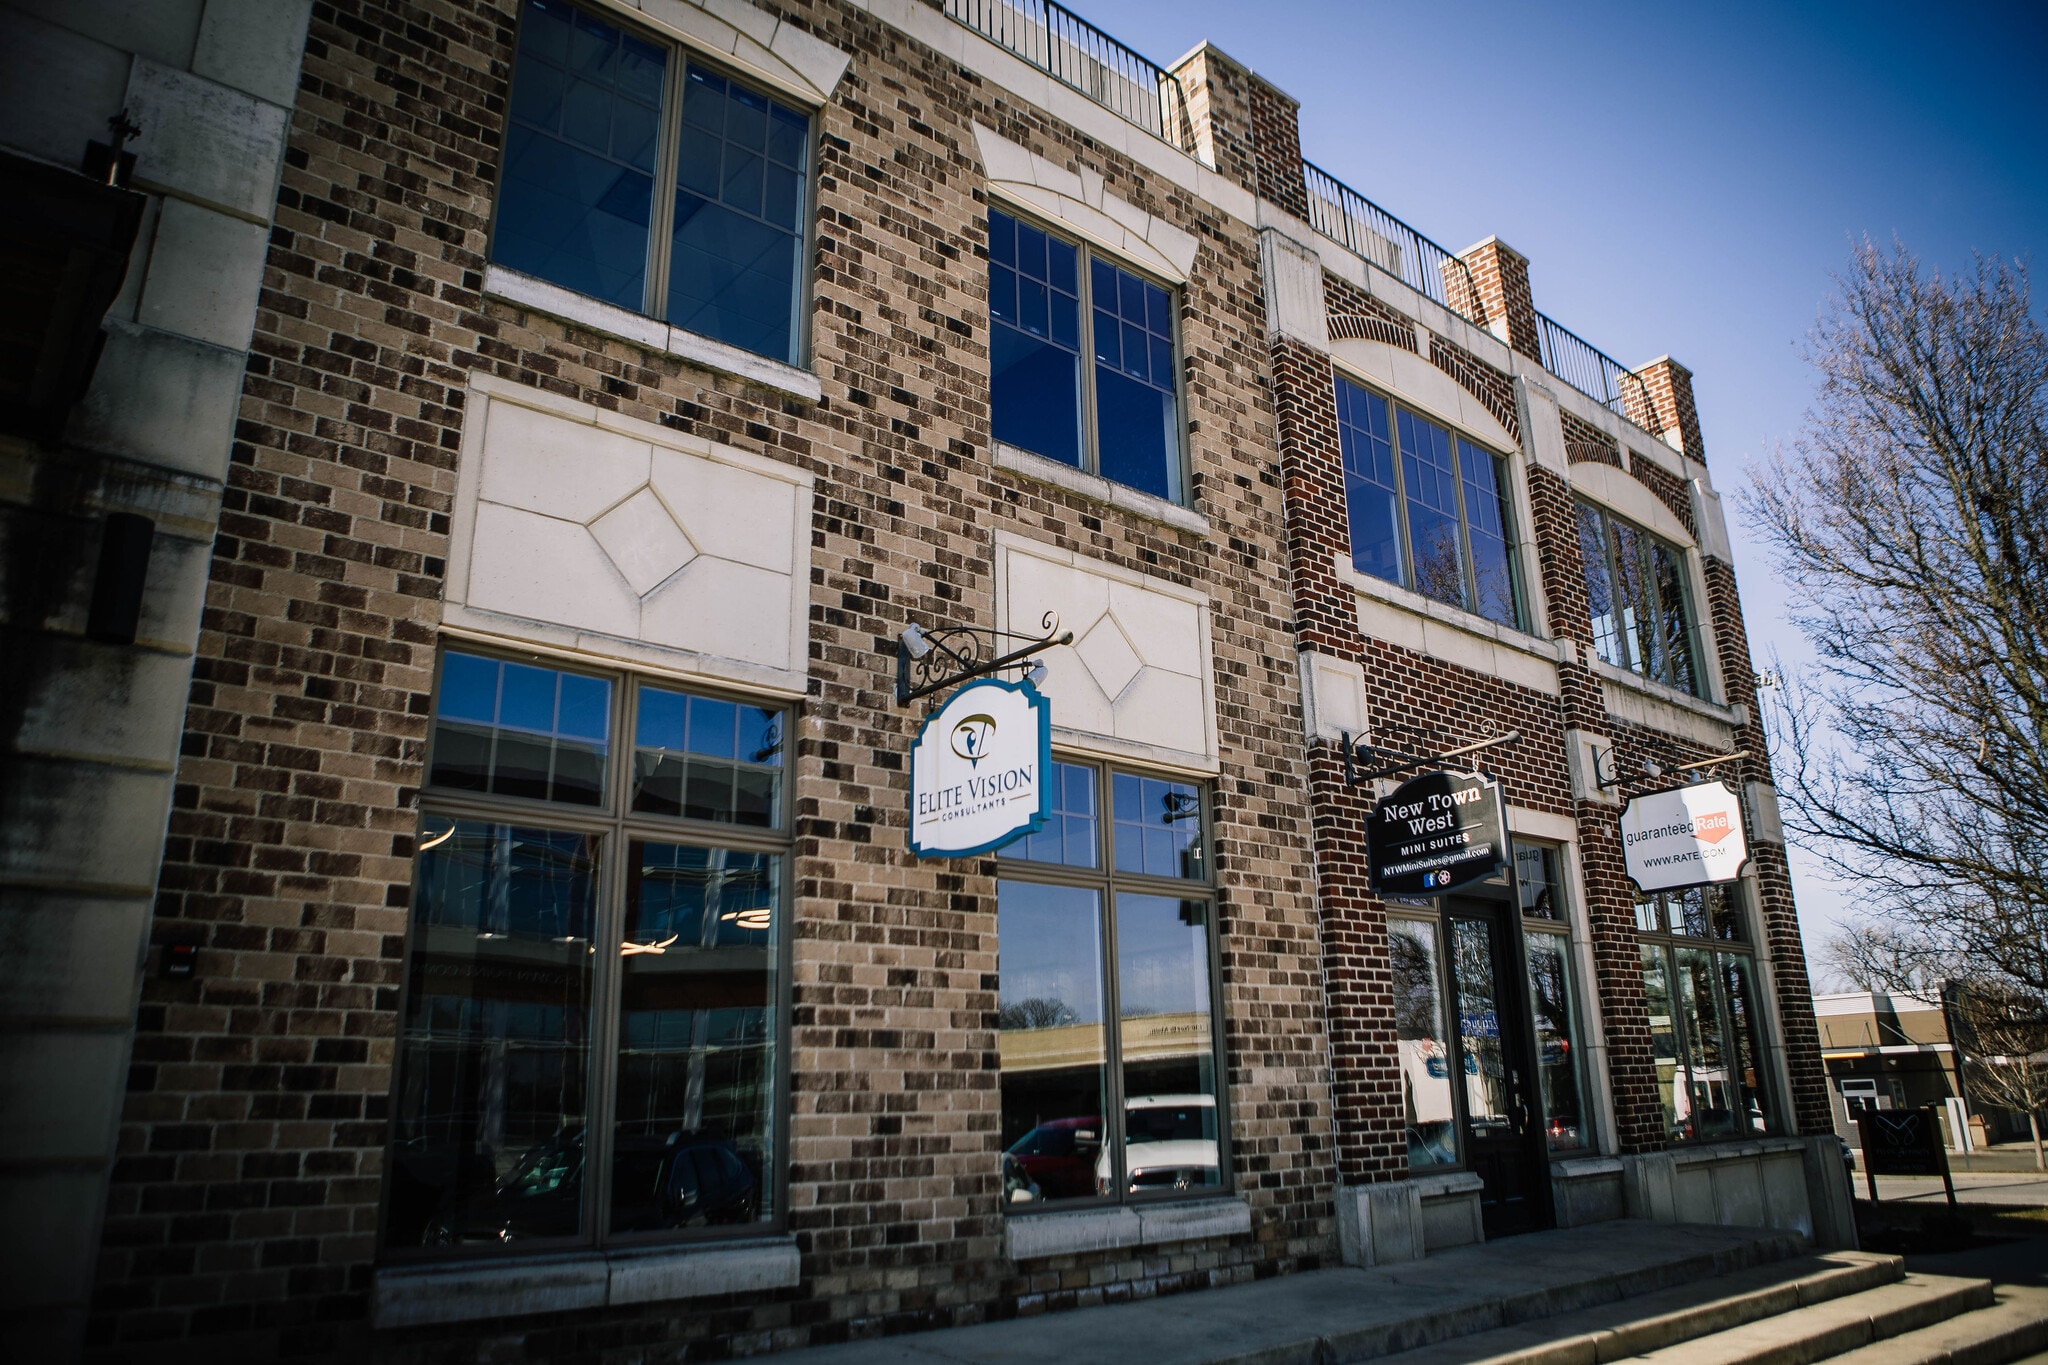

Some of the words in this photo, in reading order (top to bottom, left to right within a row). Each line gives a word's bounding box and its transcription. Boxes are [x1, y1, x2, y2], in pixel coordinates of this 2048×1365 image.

[919, 785, 963, 815] ELITE
[968, 764, 1033, 800] VISION
[941, 797, 1006, 822] CONSULTANTS
[1383, 801, 1425, 823] New
[1428, 786, 1482, 812] Town
[1407, 810, 1455, 836] West
[1626, 820, 1694, 846] guaranteed
[1696, 815, 1727, 832] Rate
[1400, 839, 1426, 856] MINI
[1430, 832, 1471, 850] SUITES
[1643, 847, 1726, 868] WWW.RATE.COM
[1383, 846, 1490, 876] NTWMiniSuites@gmail.com
